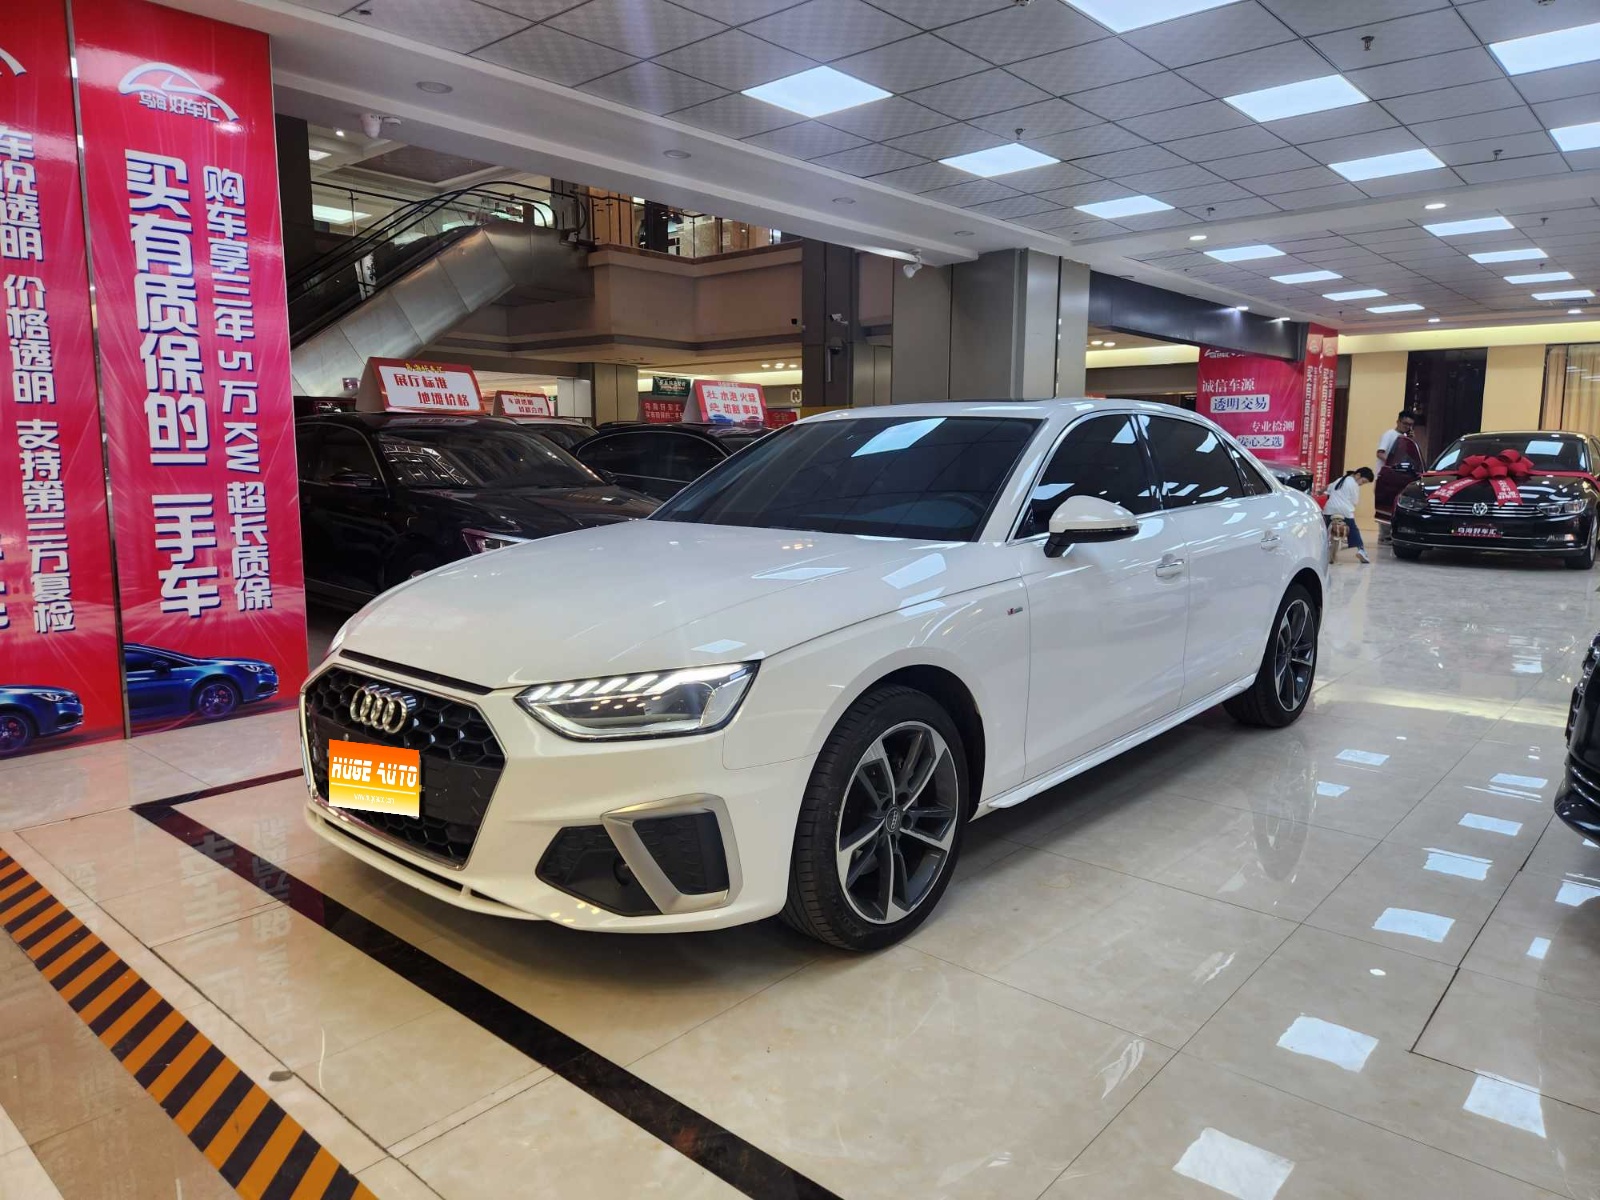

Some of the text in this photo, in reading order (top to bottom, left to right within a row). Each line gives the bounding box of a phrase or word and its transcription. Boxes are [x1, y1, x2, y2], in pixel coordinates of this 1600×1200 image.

[3, 273, 56, 403] 价格透明
[125, 149, 221, 618] 买有质保的二手车
[393, 373, 449, 389] 展厅标准
[1202, 378, 1256, 393] 诚信车源
[417, 391, 470, 407] 地摊价格
[1212, 396, 1268, 412] 透明交易
[1252, 420, 1295, 433] 专业检测
[1239, 436, 1283, 448] 安心之选
[15, 418, 76, 633] 支持第三方复检
